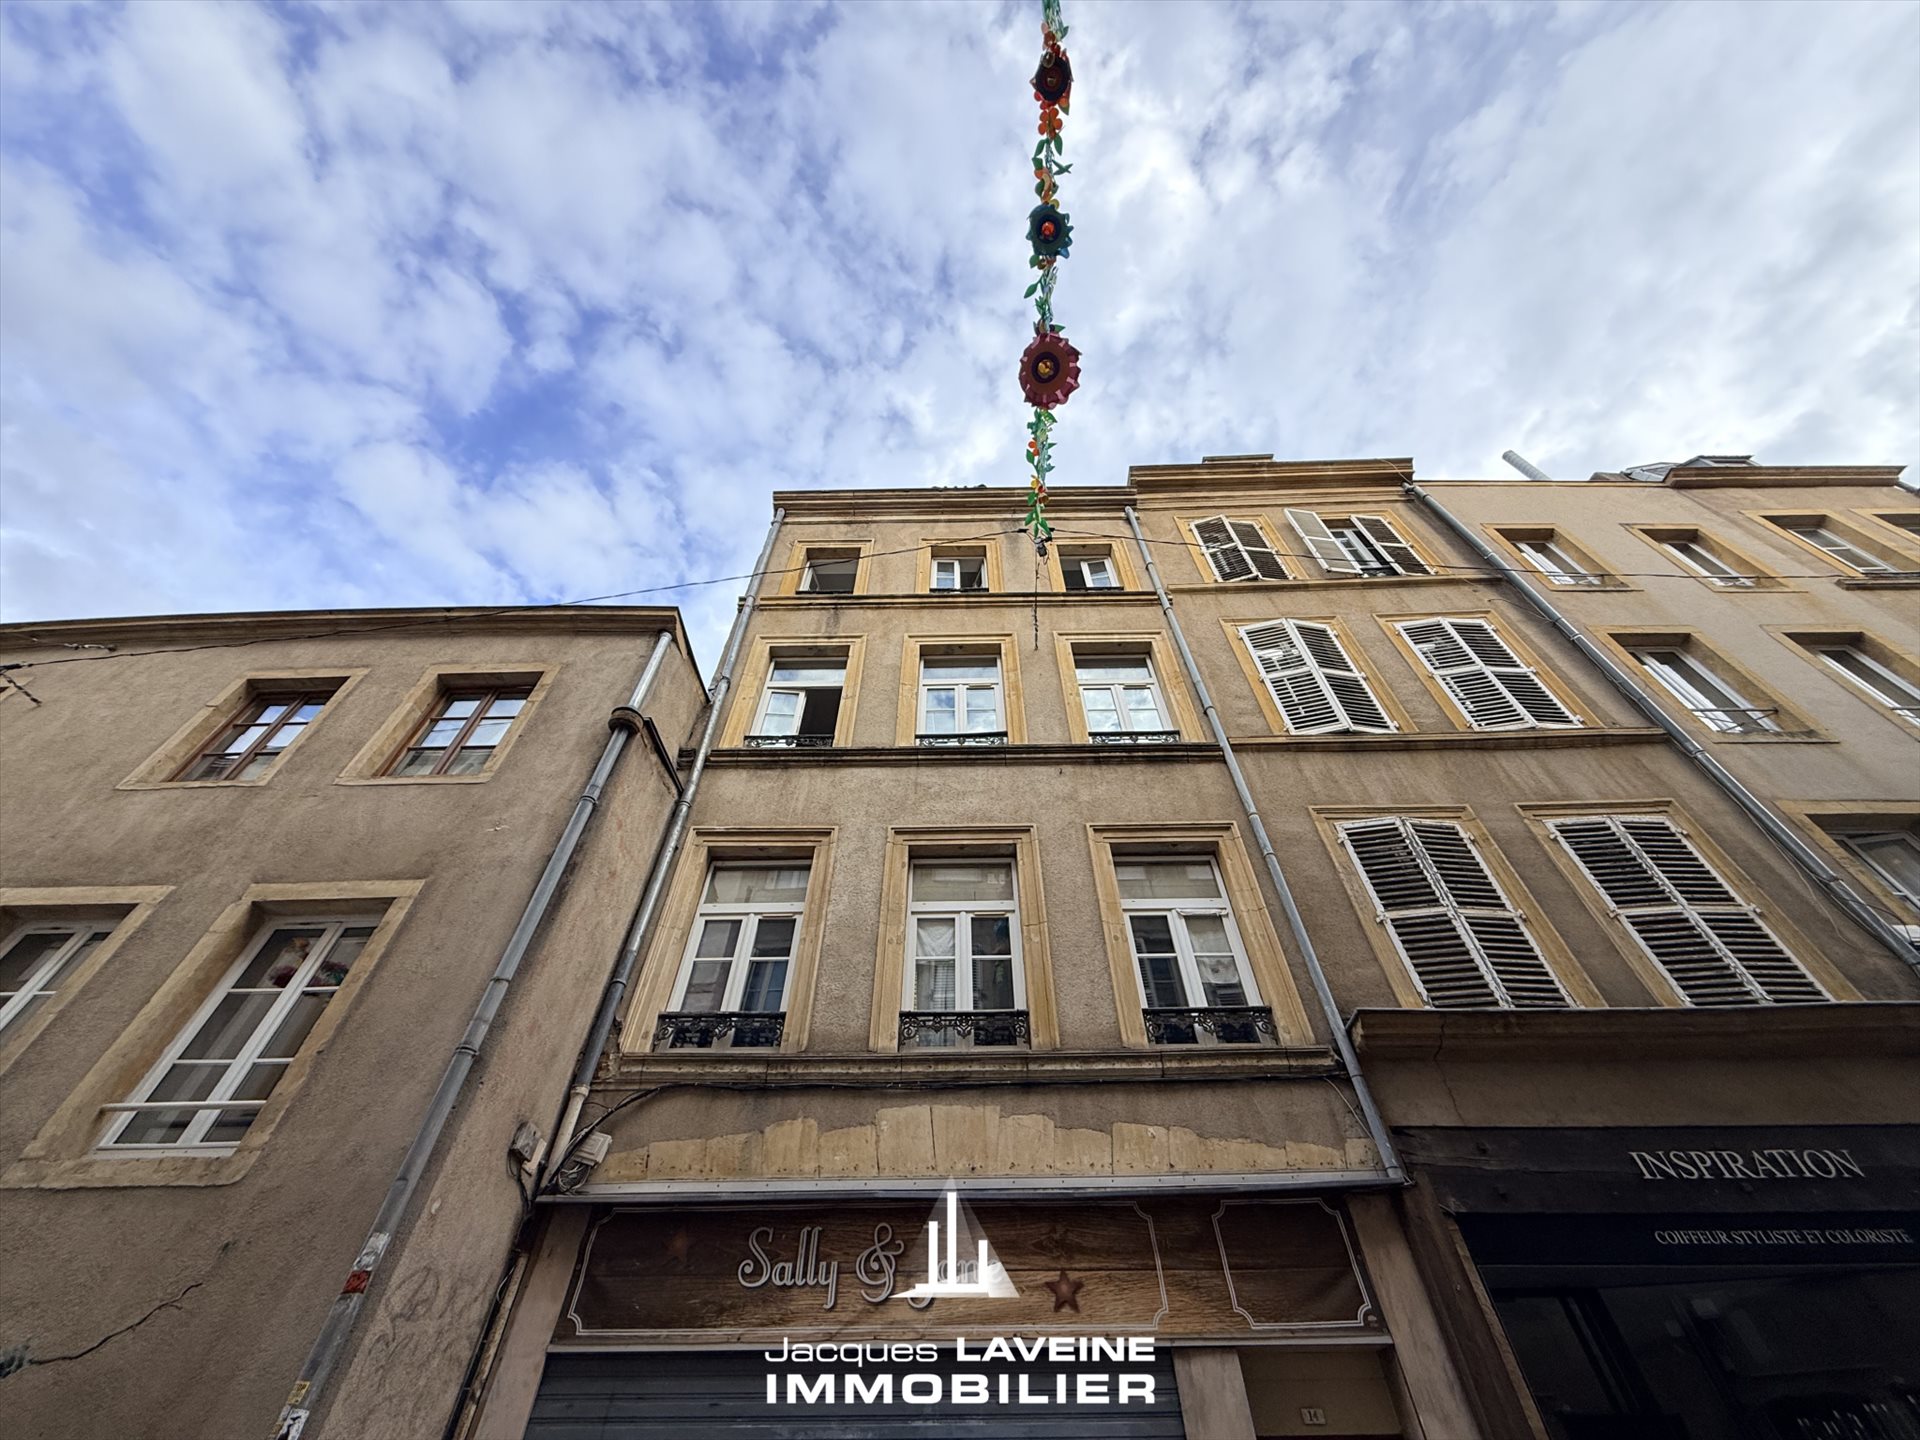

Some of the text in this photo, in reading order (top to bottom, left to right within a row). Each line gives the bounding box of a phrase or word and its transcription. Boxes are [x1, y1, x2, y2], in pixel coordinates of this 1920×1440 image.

[1628, 1149, 1866, 1180] INSPIRATION
[1654, 1228, 1914, 1245] COIFFEUR STYLISTE ET COLORISTE
[738, 1226, 839, 1309] Sally
[855, 1222, 905, 1302] &
